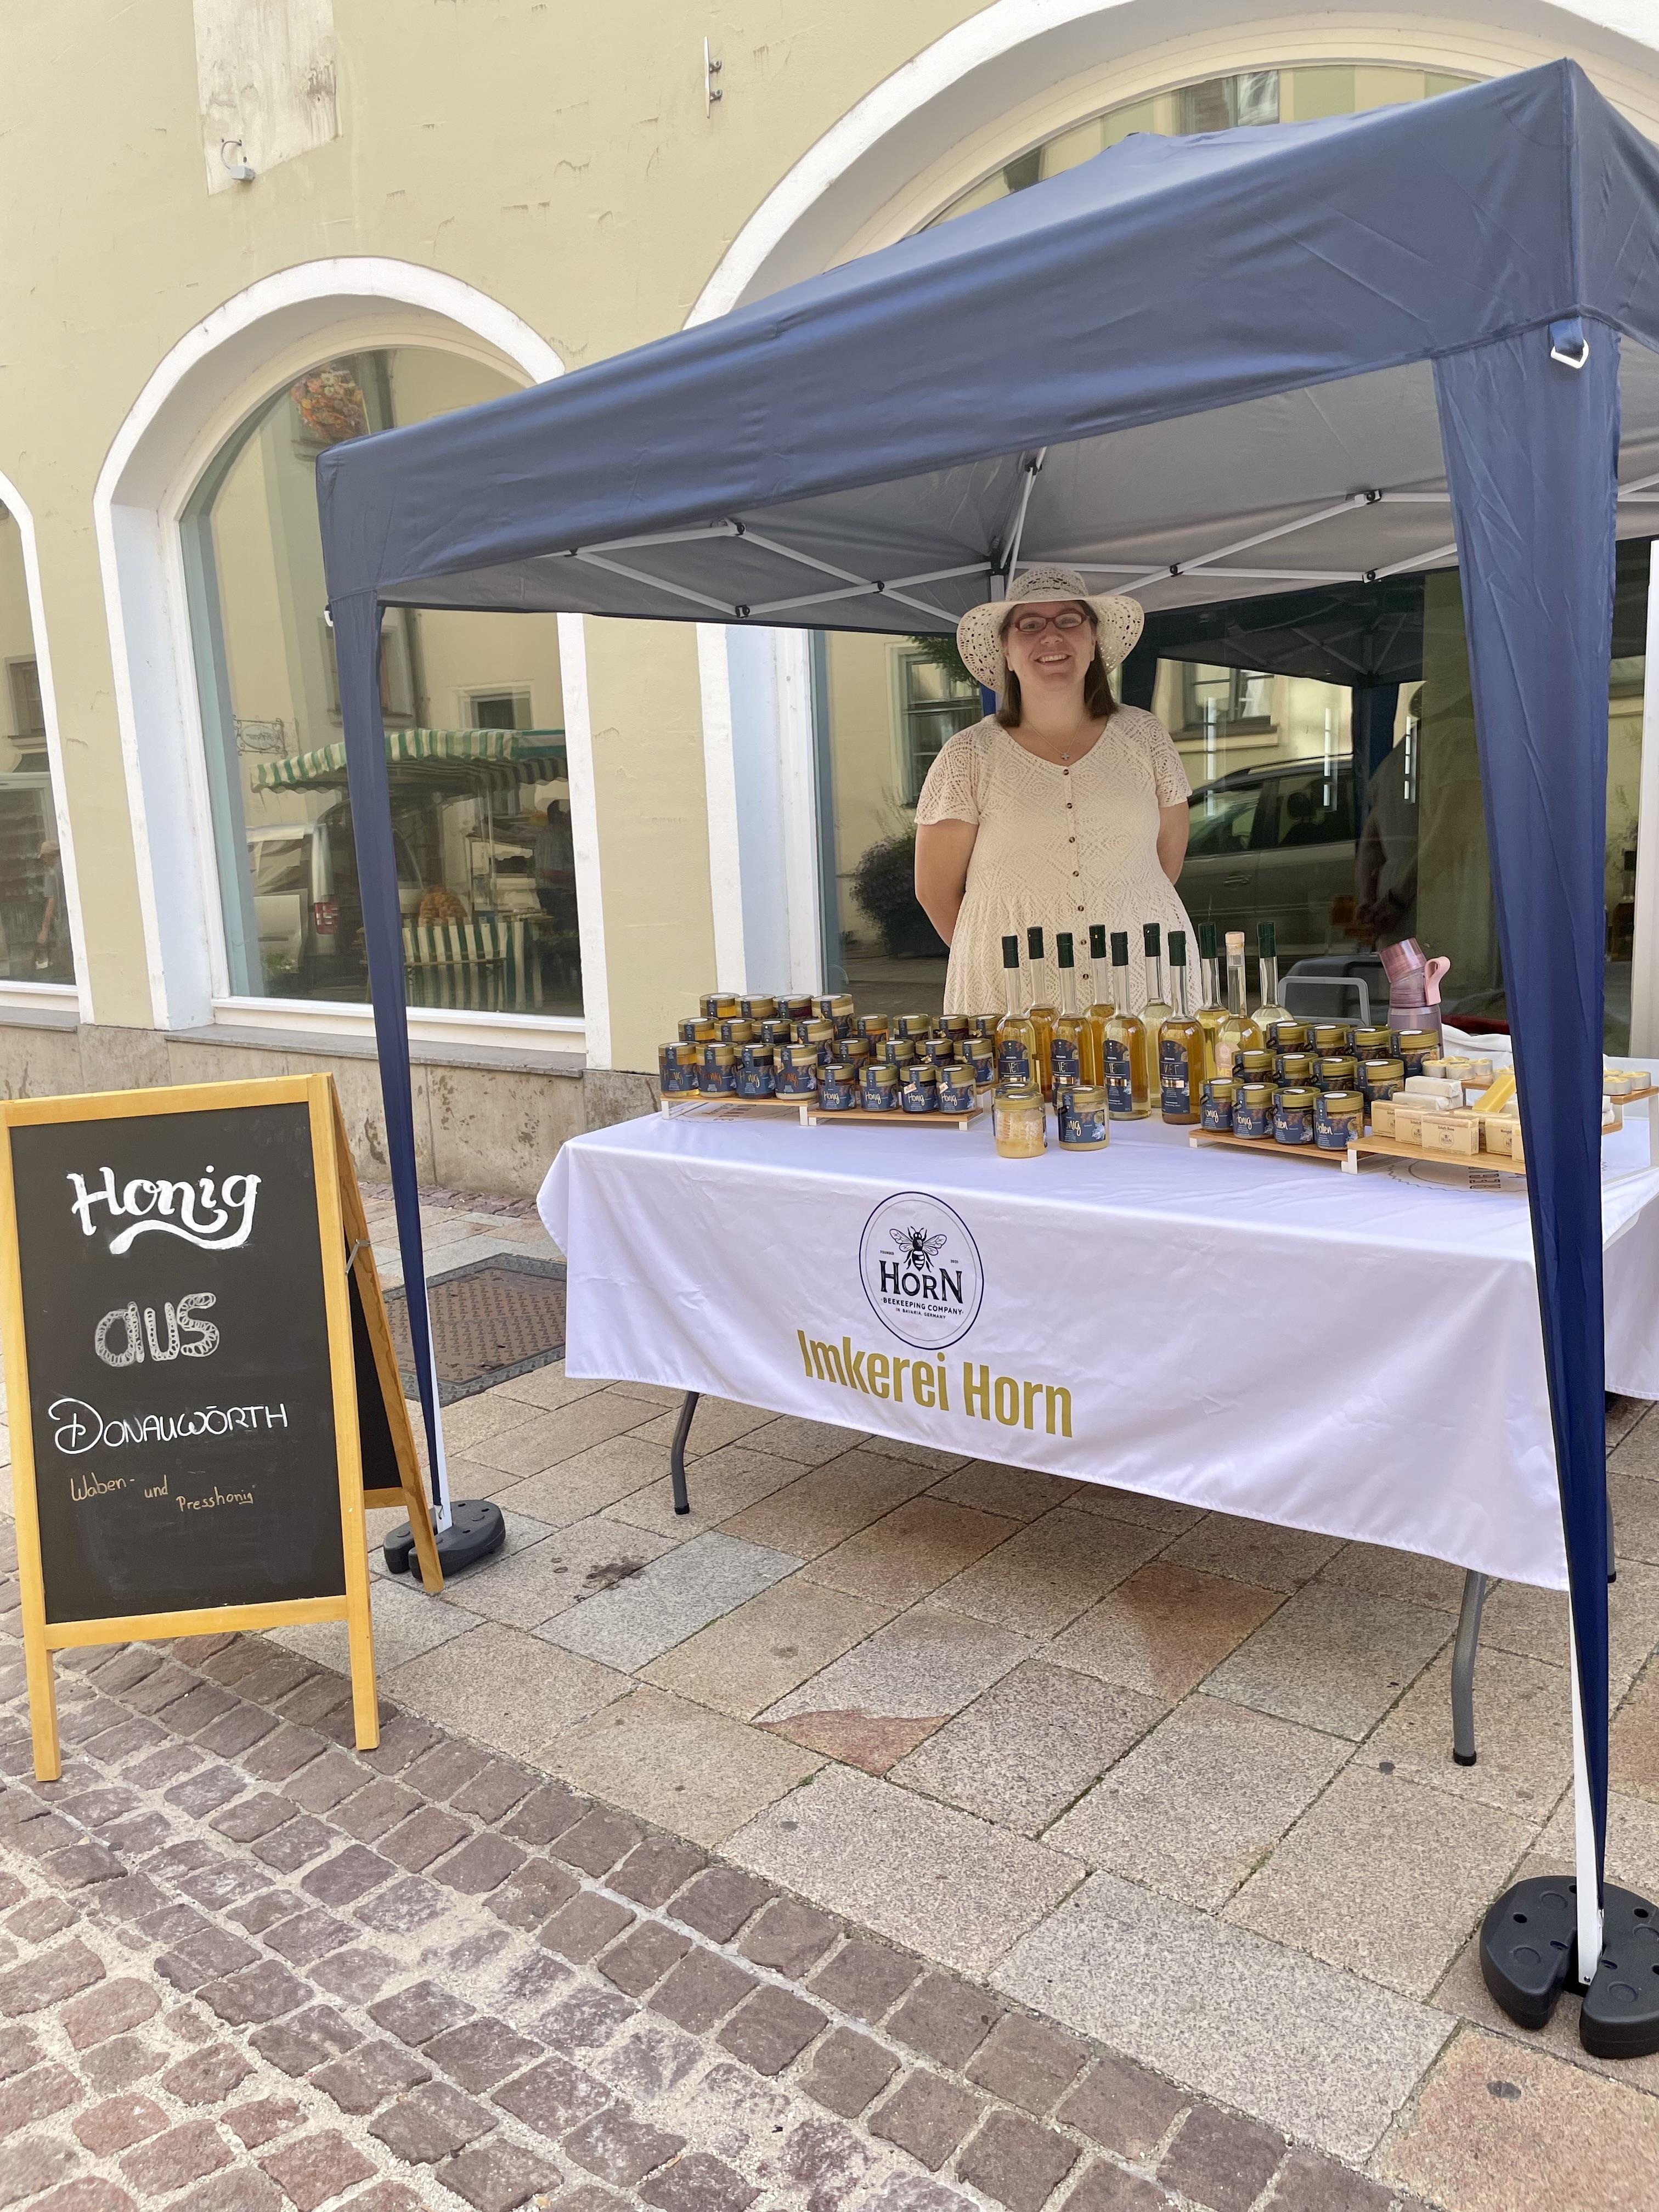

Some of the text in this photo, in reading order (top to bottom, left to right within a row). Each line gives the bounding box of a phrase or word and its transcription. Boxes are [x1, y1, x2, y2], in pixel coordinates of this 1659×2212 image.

[1217, 1066, 1232, 1077] ME
[823, 1091, 840, 1104] Honig
[865, 1091, 881, 1105] Honig
[908, 1092, 925, 1106] Honig
[941, 1092, 957, 1107] Honig
[1205, 1109, 1219, 1123] onig
[66, 1165, 262, 1255] Honig
[879, 1260, 963, 1304] HORN
[883, 1297, 963, 1316] BEEKEEPING COMPANY
[95, 1291, 221, 1368] aus
[797, 1329, 1073, 1438] Imkerei Horn
[71, 1472, 254, 1512] Waben- und Presshonig
